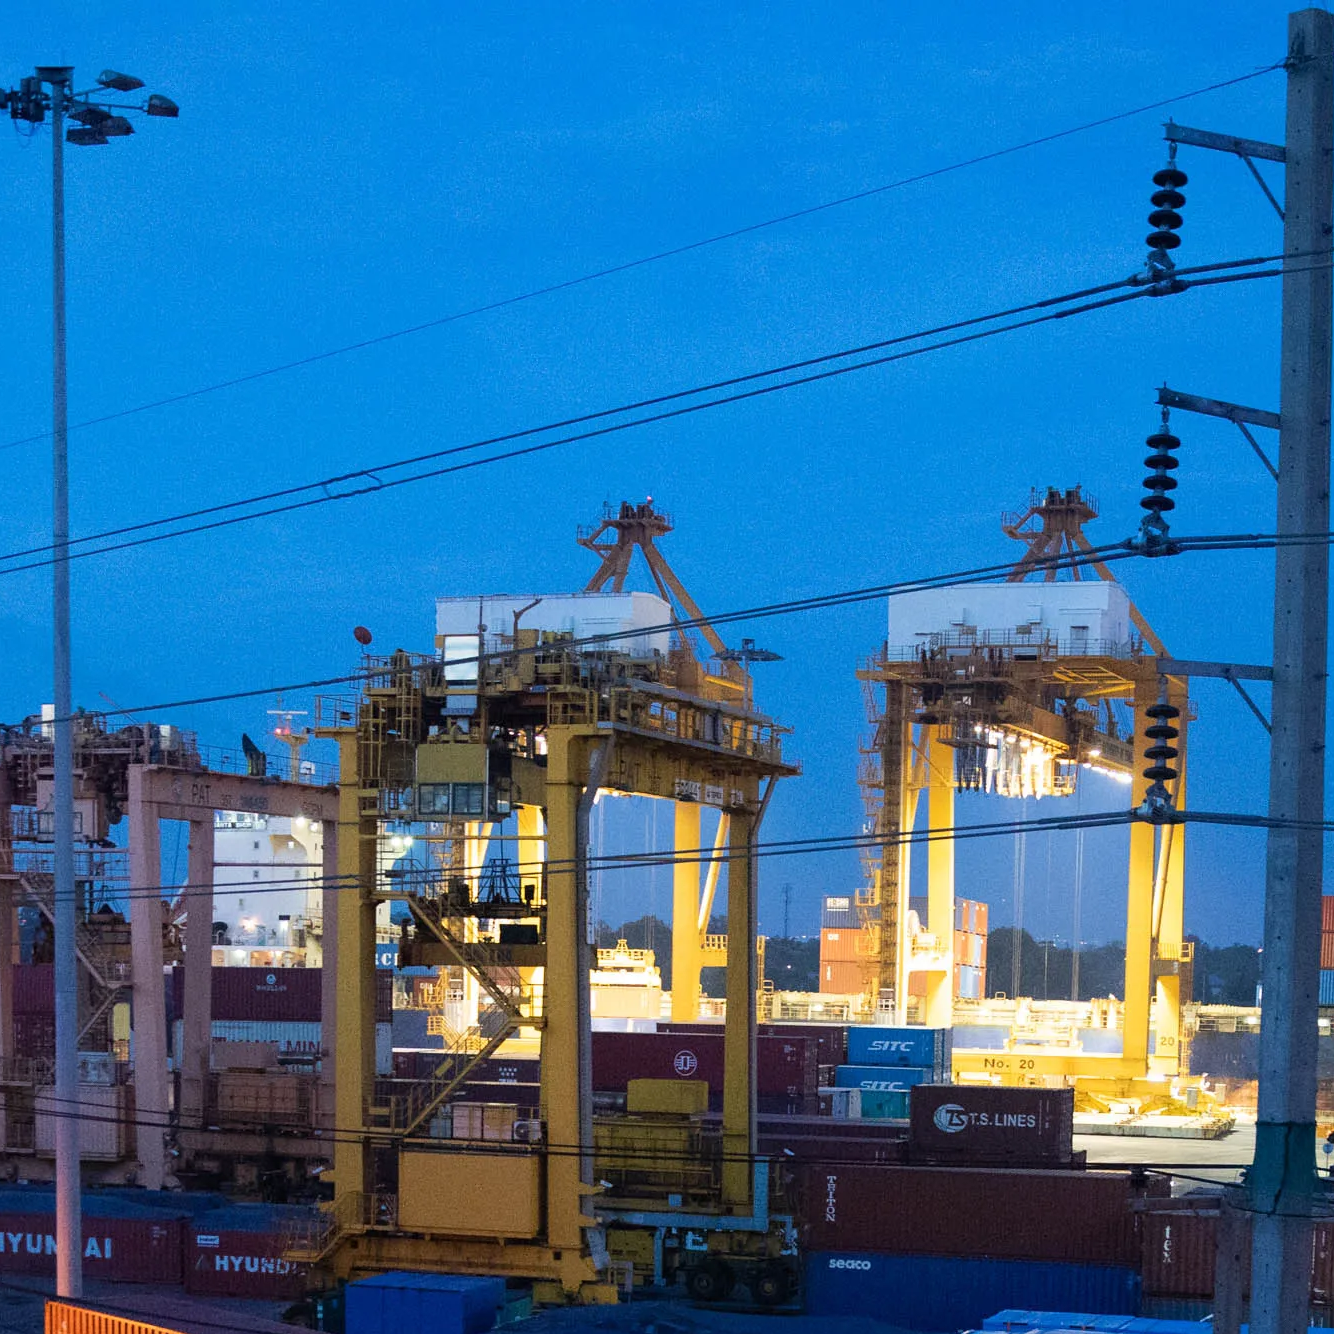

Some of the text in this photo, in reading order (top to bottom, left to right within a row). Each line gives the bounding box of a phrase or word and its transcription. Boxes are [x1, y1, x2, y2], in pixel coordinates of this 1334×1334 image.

[867, 1040, 915, 1052] SITC
[984, 1058, 1035, 1070] No. 20
[859, 1080, 904, 1091] SITC
[969, 1112, 993, 1126] T.S.
[995, 1113, 1036, 1128] LINES
[825, 1175, 837, 1222] TRITON
[1163, 1225, 1172, 1263] tex
[214, 1254, 305, 1276] HYUND
[828, 1259, 871, 1270] seaco
